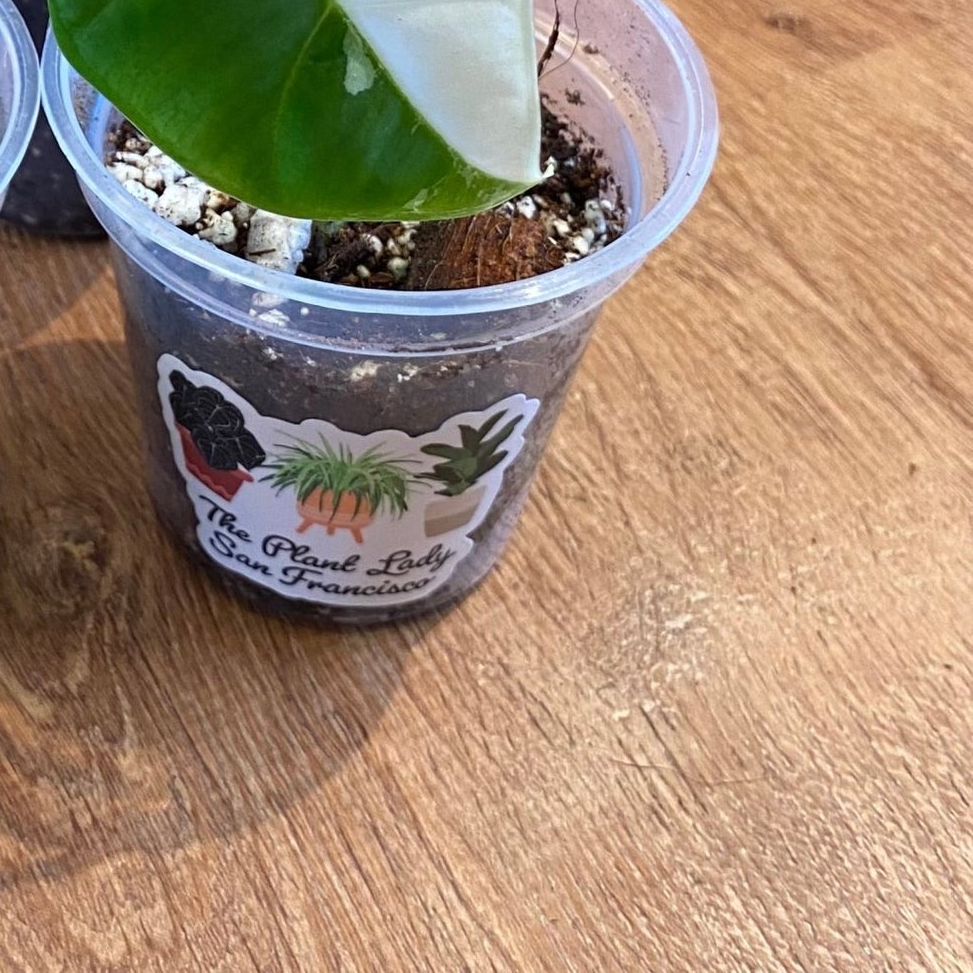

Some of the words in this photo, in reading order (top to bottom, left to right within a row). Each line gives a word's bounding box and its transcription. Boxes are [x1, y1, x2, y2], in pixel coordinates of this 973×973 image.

[199, 494, 252, 543] The
[262, 534, 360, 573] Plant
[366, 543, 456, 575] Lady
[209, 530, 273, 576] San
[279, 565, 436, 596] Francisco
